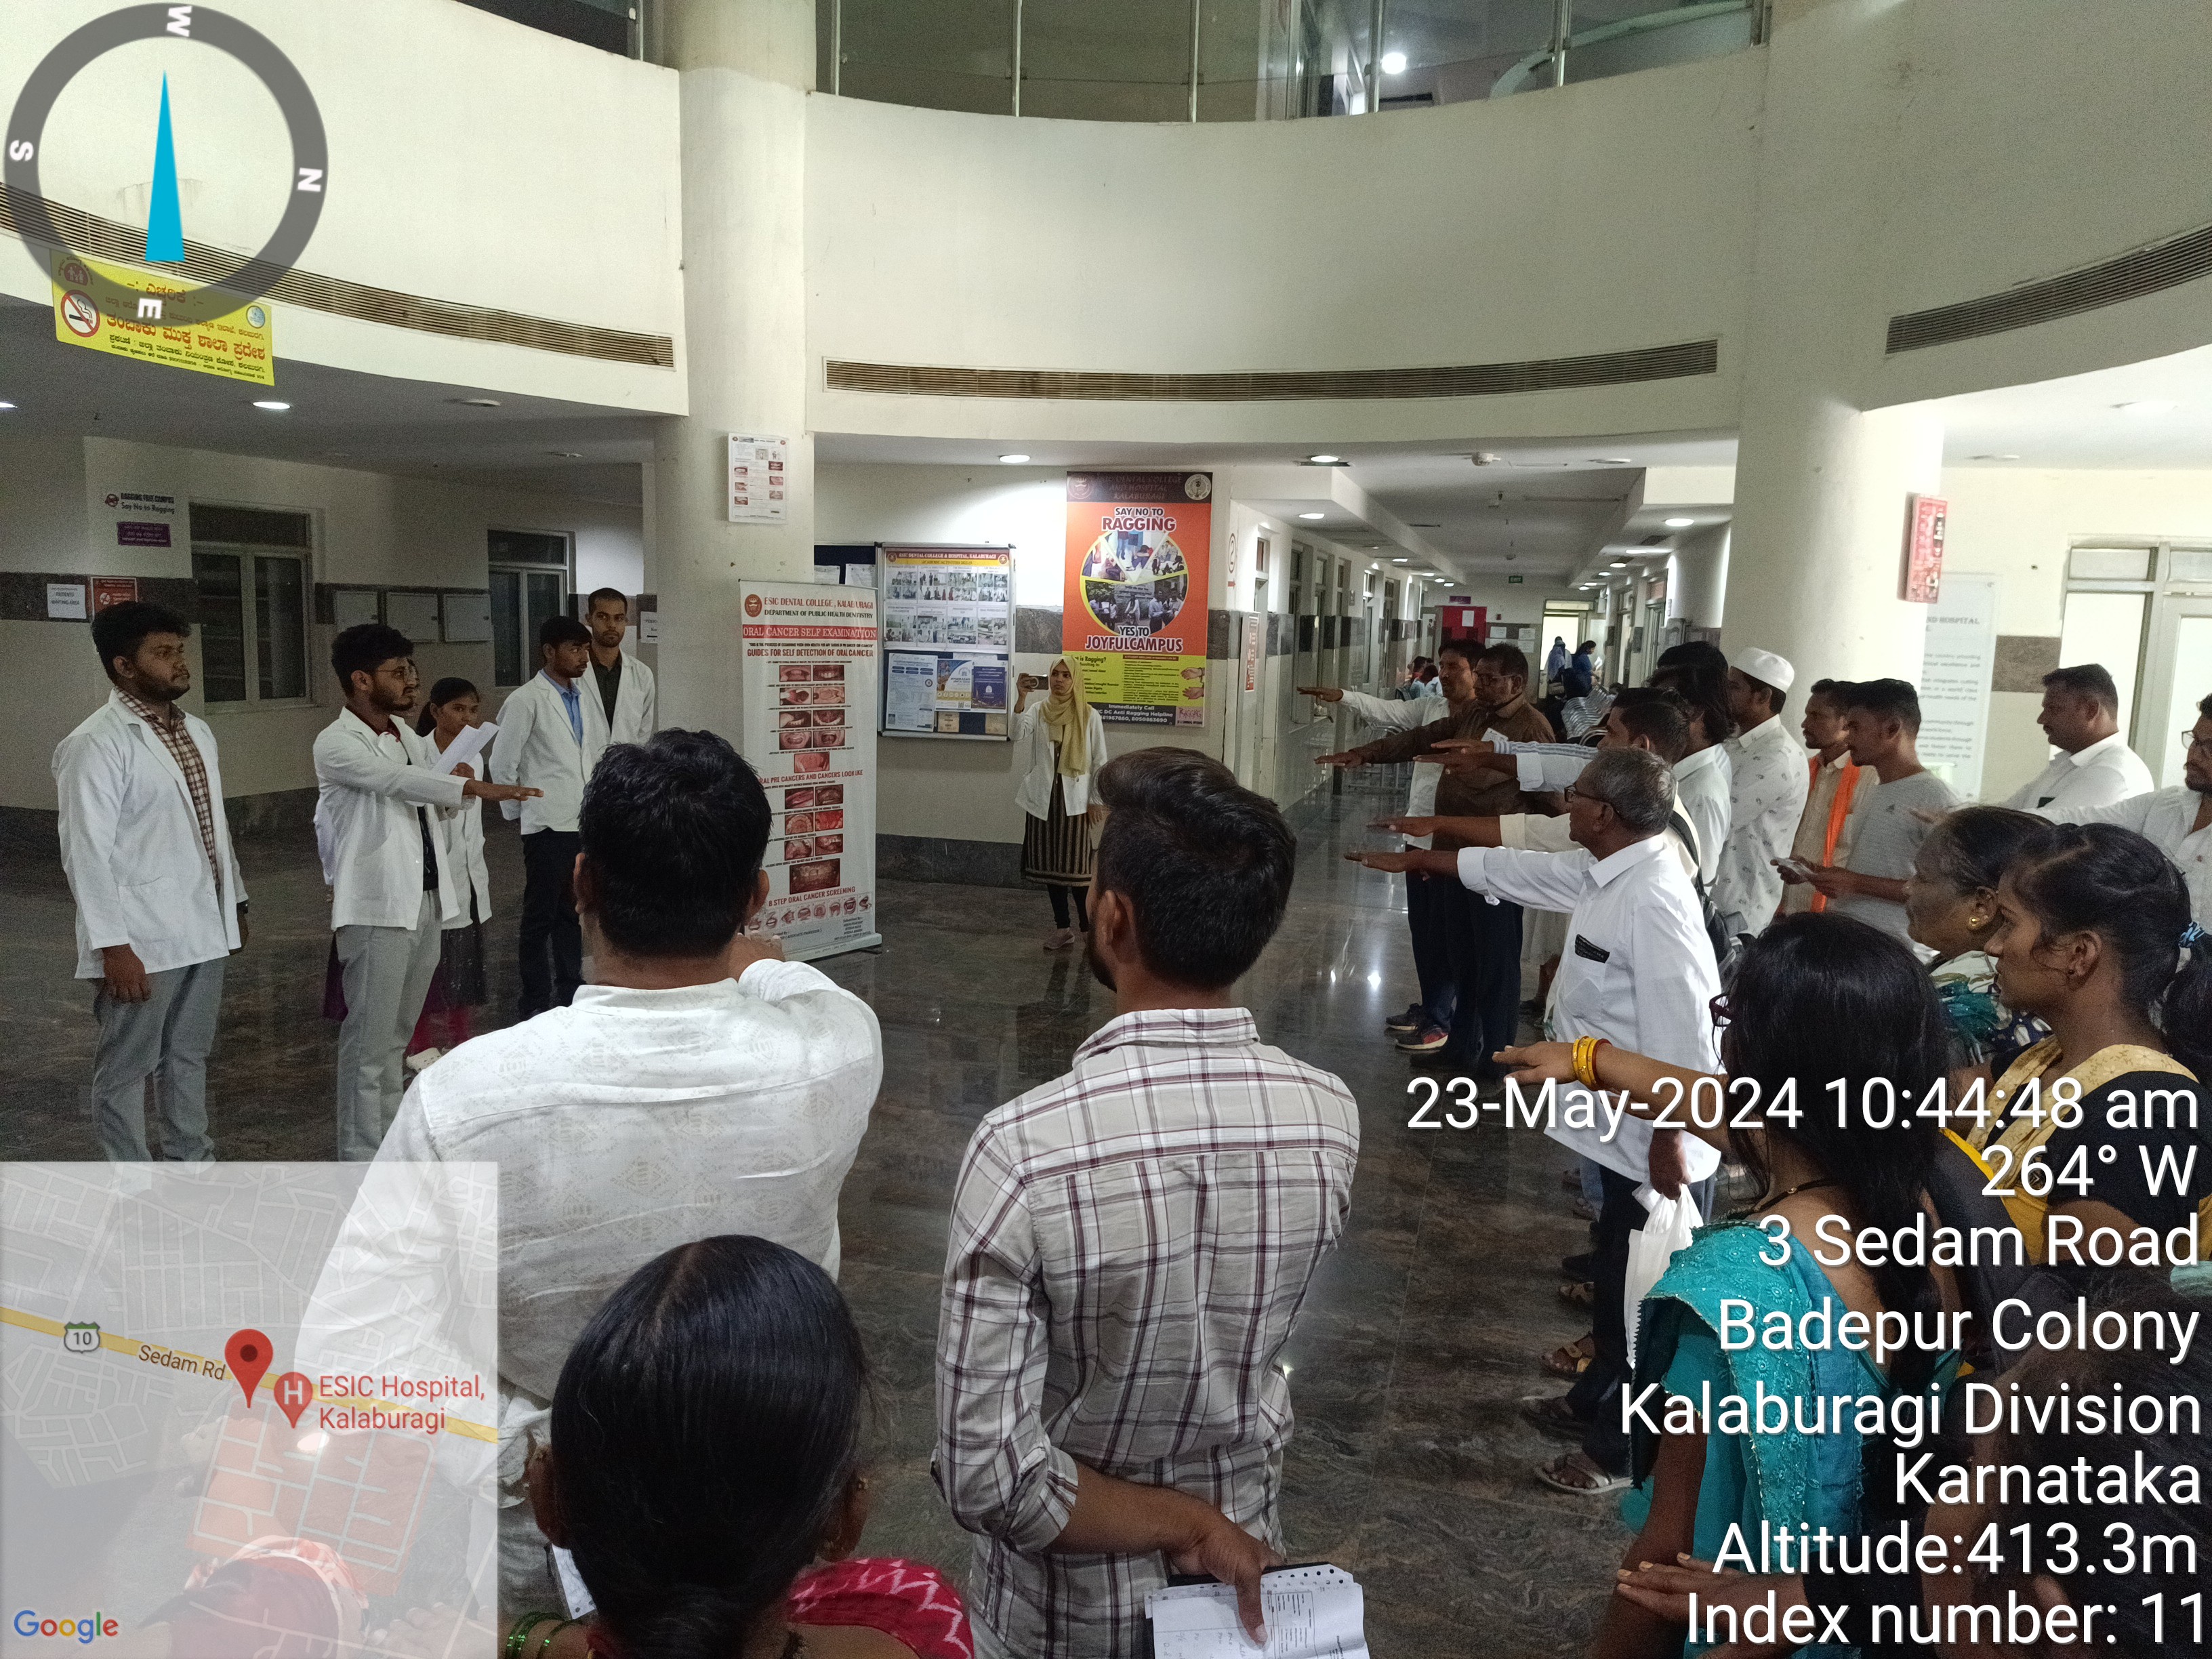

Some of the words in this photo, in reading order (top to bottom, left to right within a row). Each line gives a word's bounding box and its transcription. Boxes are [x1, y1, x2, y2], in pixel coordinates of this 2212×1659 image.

[106, 312, 157, 336] ತಂಬಾಕು
[163, 325, 192, 350] ಮುಕ್ತ
[197, 335, 228, 352] ಶಾಲಾ
[234, 340, 266, 361] ಪ್ರದೇಶ
[1103, 517, 1176, 531] RAGGING
[764, 597, 779, 605] ESIC
[781, 598, 804, 607] DENTAL
[837, 600, 874, 609] KALABURAGI
[743, 627, 764, 636] ORAL
[766, 627, 799, 637] CANCER
[801, 628, 821, 637] SELF
[823, 628, 877, 638] EXAMINATION
[1120, 626, 1135, 636] YES
[1138, 627, 1149, 636] TO
[747, 649, 769, 657] GUIDES
[771, 649, 781, 657] FOR
[783, 649, 795, 657] SELF
[796, 649, 827, 657] DETECTION
[827, 649, 834, 657] OF
[836, 649, 847, 657] ORAL
[848, 649, 874, 657] CANCER
[781, 774, 805, 783] CANCERS
[817, 771, 841, 779] CANCERS
[773, 897, 787, 905] STEP
[788, 895, 802, 903] ORAL
[804, 891, 825, 901] CANCER
[826, 886, 855, 897] SCREENING
